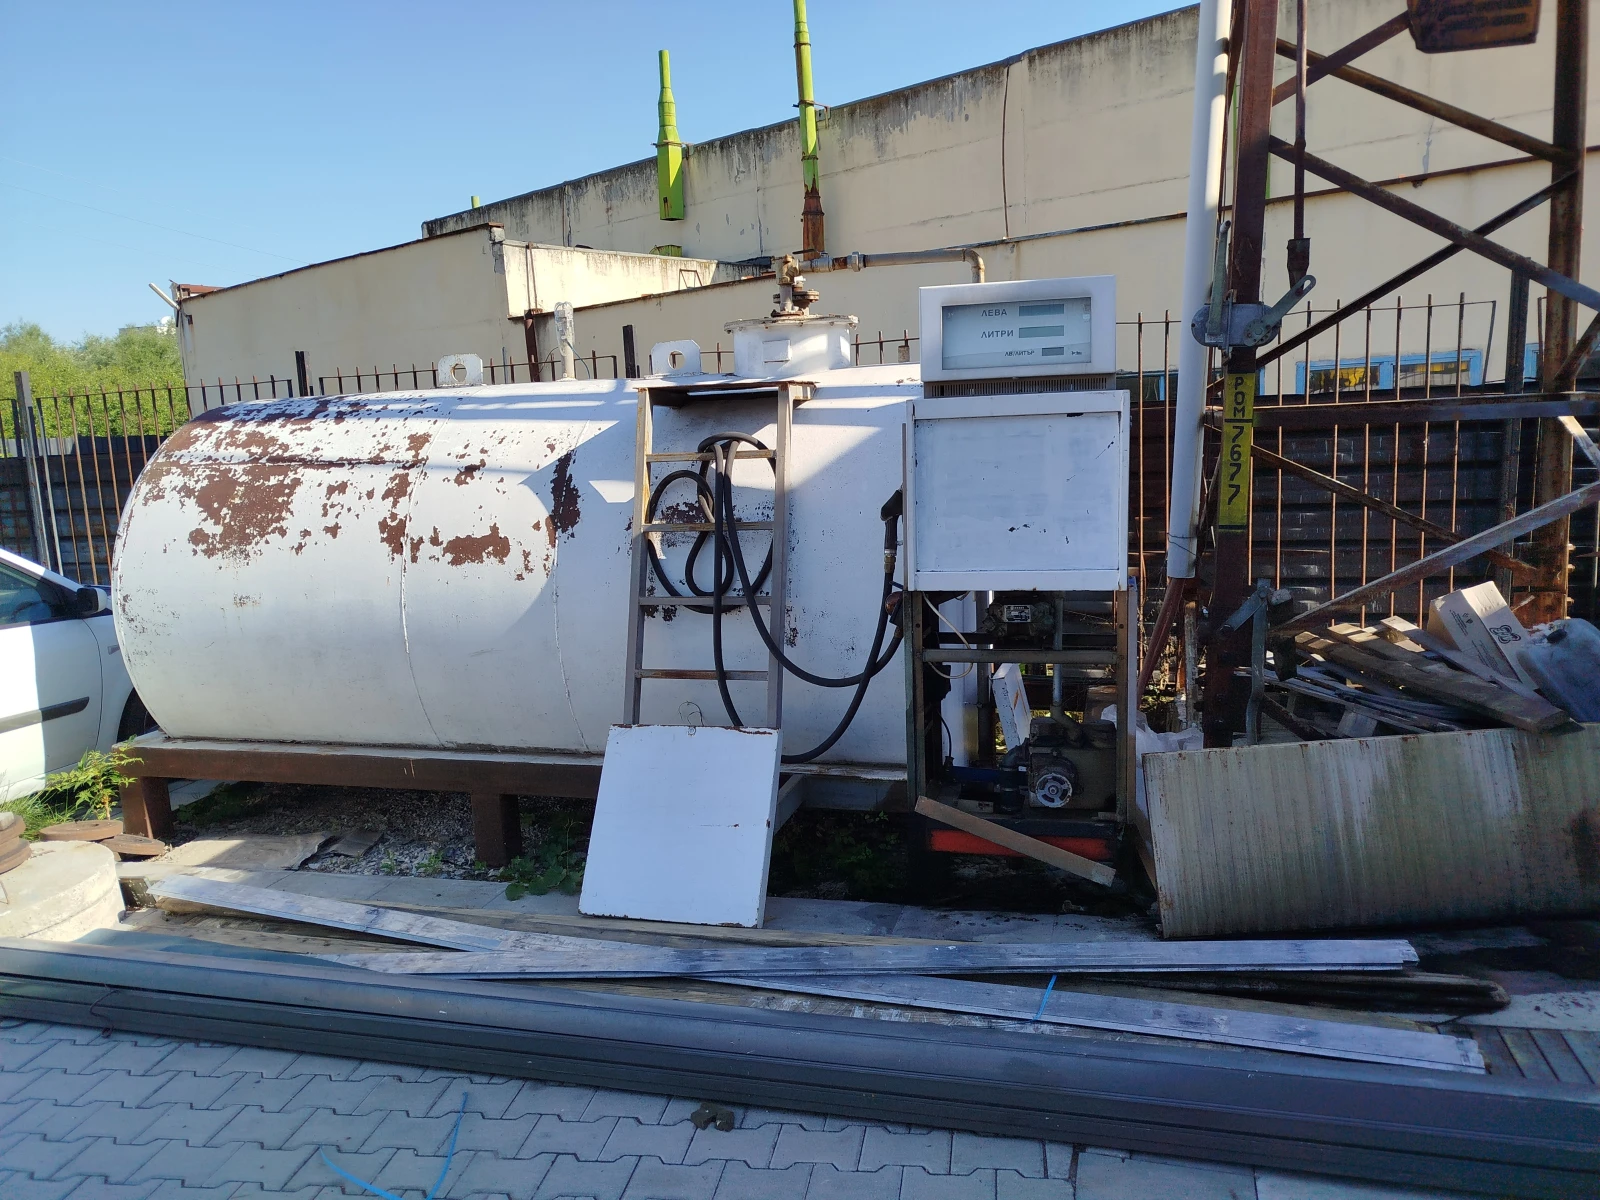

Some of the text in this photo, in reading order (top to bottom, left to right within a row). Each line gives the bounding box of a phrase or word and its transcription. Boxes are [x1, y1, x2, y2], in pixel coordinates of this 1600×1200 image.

[981, 308, 1008, 318] ЛЕВА
[980, 329, 1014, 339] ЛИТРИ
[1227, 426, 1245, 506] 7677
